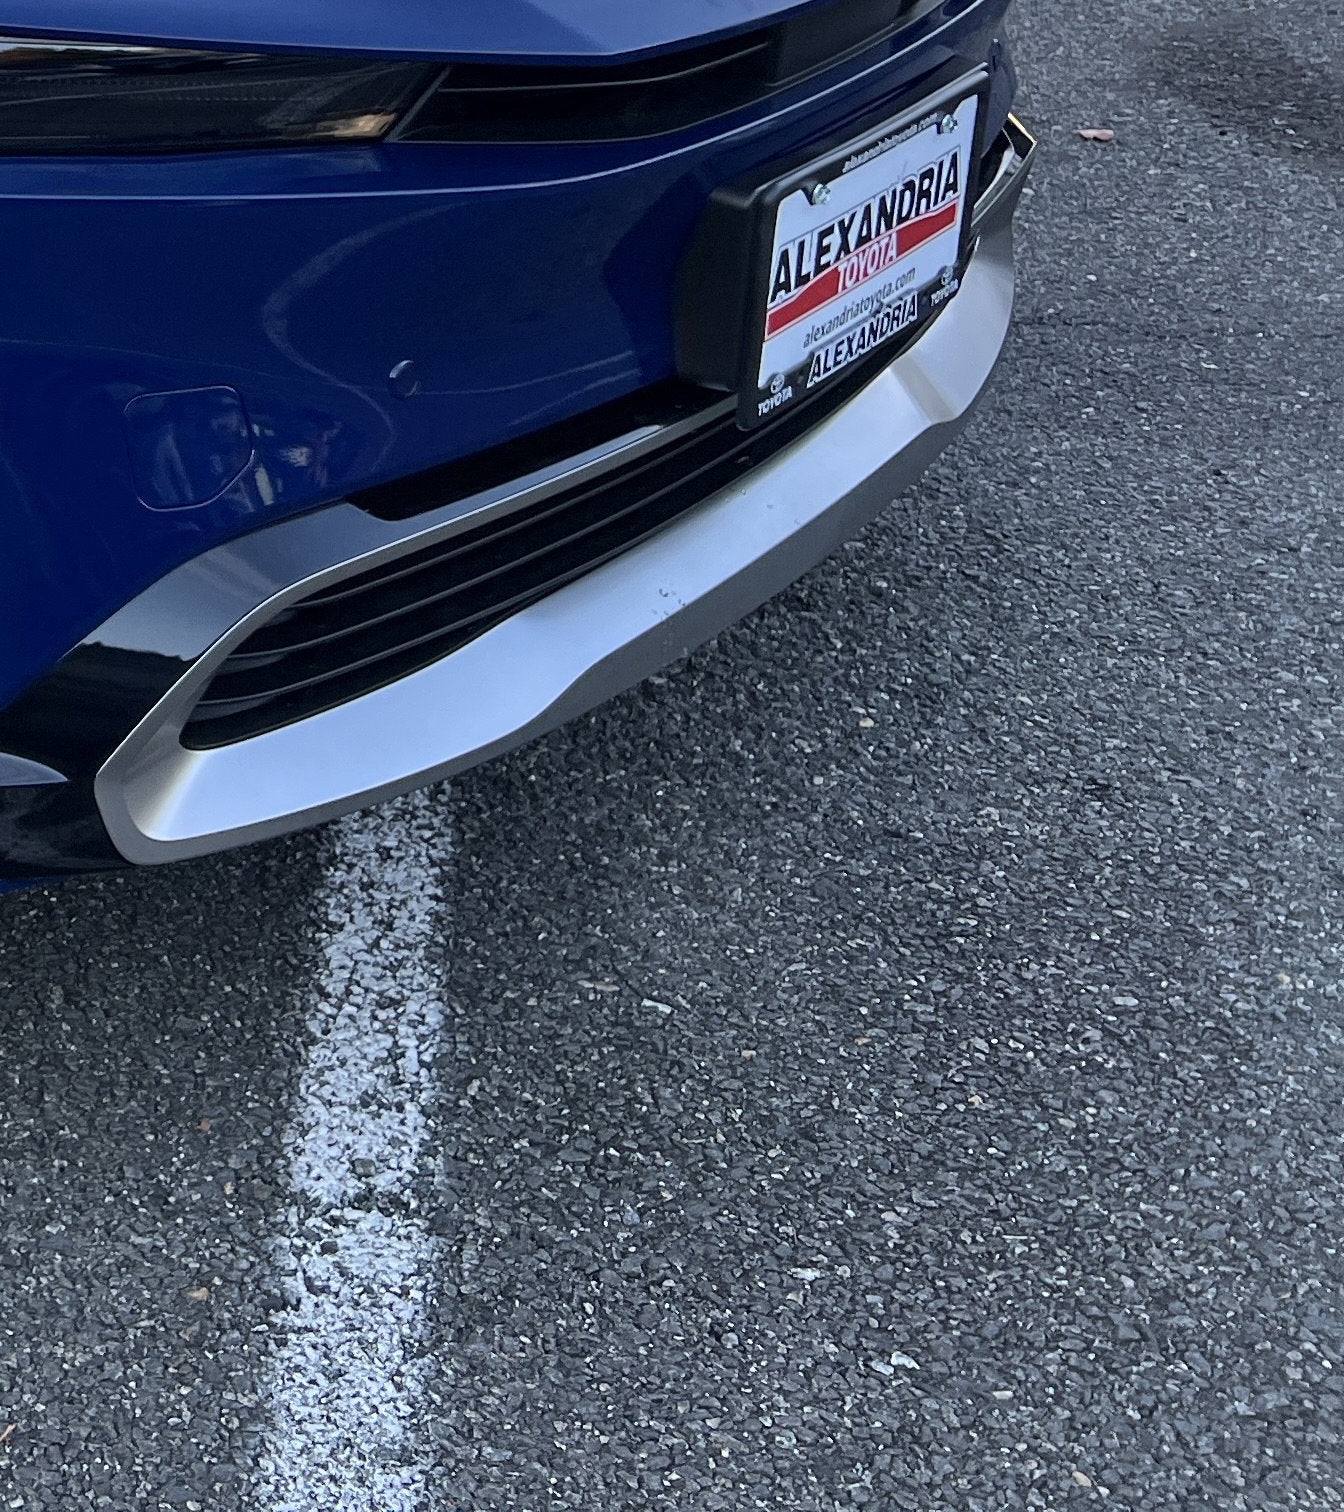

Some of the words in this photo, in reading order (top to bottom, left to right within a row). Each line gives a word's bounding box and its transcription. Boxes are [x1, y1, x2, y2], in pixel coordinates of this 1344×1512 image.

[769, 152, 960, 304] ALEXANDRIA
[838, 231, 898, 294] TOYOTA
[803, 267, 916, 348] alexandriatoyota.com
[809, 295, 917, 383] ALEXANDRIA
[757, 388, 793, 416] TOYOTA
